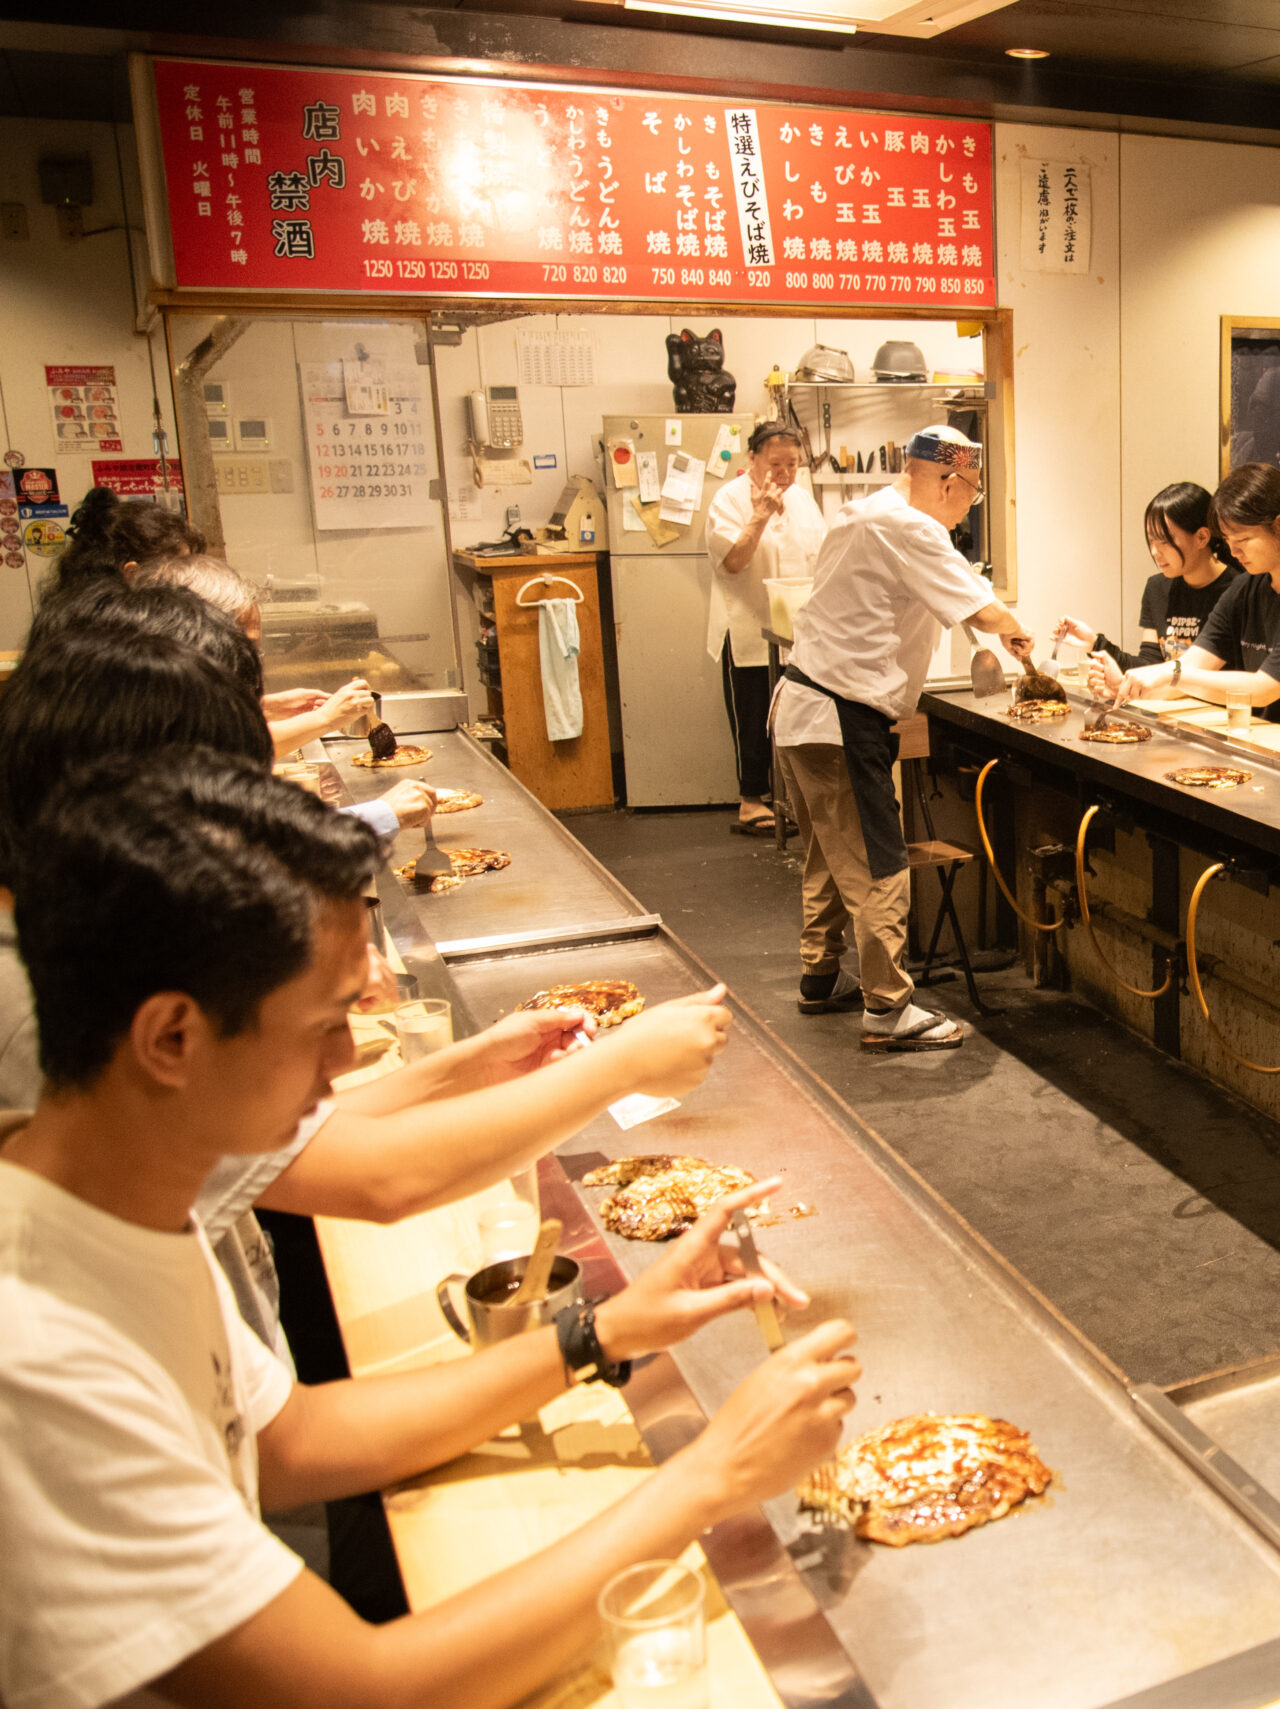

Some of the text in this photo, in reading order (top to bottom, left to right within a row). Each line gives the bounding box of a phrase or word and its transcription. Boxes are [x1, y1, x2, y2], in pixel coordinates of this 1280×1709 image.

[184, 84, 211, 216] 定休日 火曜日
[238, 88, 261, 165] 営業時間
[302, 100, 346, 189] 店内
[596, 107, 623, 256] きもうどん焼
[642, 112, 671, 255] そば焼
[674, 113, 700, 257] かしわそば焼
[704, 114, 728, 258] きもそば焼
[731, 112, 770, 265] 特選えびそば焼
[779, 122, 806, 260] かしわ焼
[809, 123, 832, 261] きも焼
[268, 171, 315, 259] 禁酒
[834, 125, 858, 262] えび玉焼
[859, 130, 884, 263] いか玉焼
[884, 130, 909, 264] 豚玉焼
[910, 131, 934, 265] 肉玉焼
[935, 135, 958, 266] かしわ玉焼
[961, 136, 982, 267] きも玉焼
[364, 260, 984, 294] 1250 1250 1250 1250 720 820 820 750 840 840 920 800 800 770 770 770 790 850 850
[316, 424, 422, 436] 5 6 7 8 9 10 11
[316, 444, 424, 457] 12 13 14 15 16 17 18
[318, 464, 427, 478] 19 20 21 22 23 24 25
[395, 402, 418, 415] 3 4
[320, 484, 412, 498] 26 27 28 29 30 31
